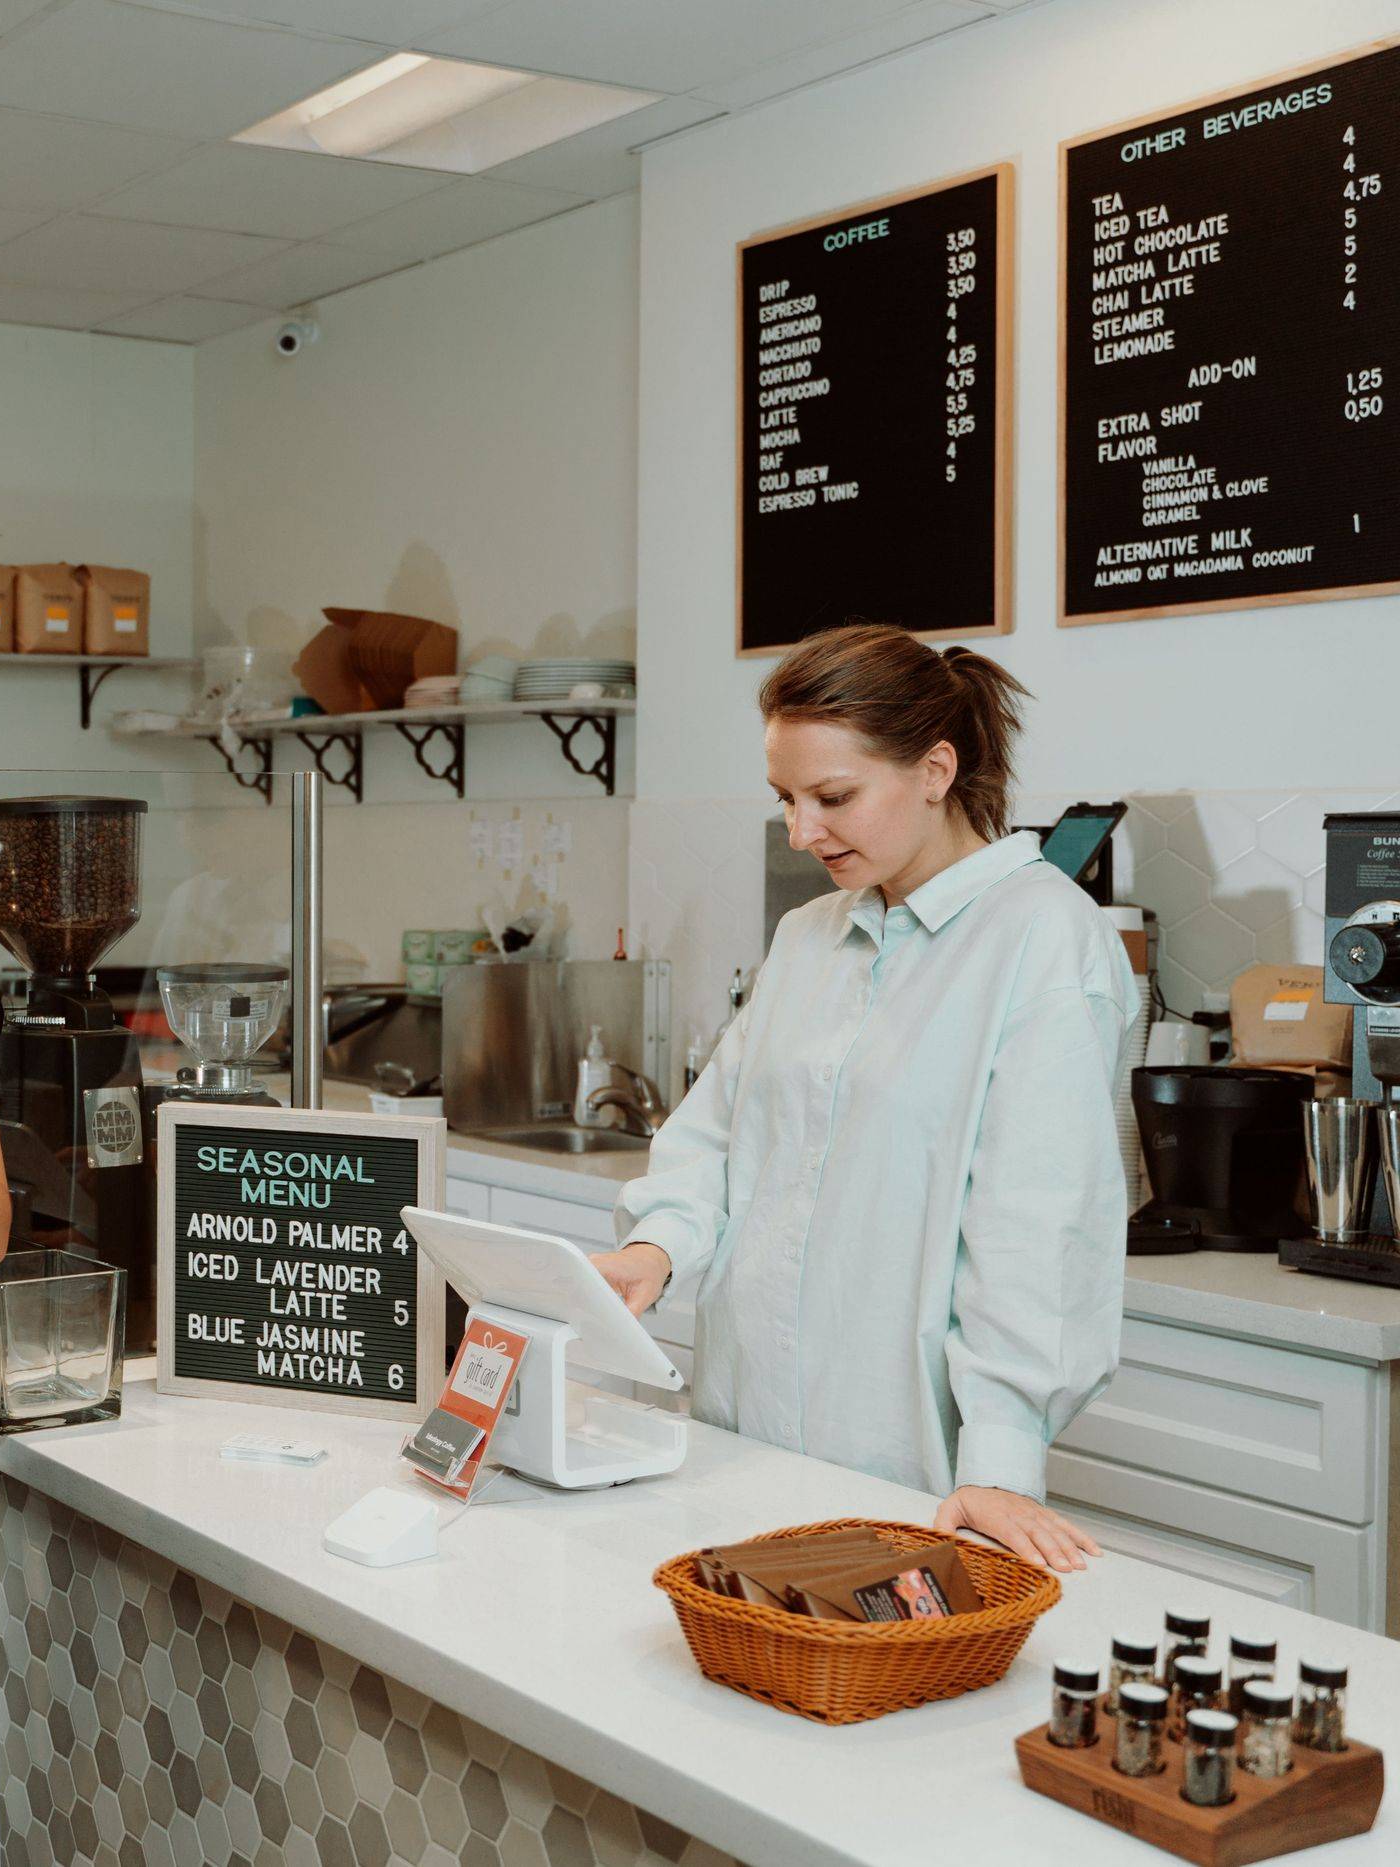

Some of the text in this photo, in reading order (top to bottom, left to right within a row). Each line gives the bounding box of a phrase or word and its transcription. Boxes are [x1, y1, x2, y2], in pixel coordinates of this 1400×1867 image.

[1120, 83, 1332, 164] OTHER BEVERAGES
[1092, 126, 1355, 216] TEA 4
[1094, 153, 1355, 241] ICED TEA 4
[823, 219, 890, 252] COFFEE
[1093, 174, 1381, 266] HOT CHOCOLATE 4.75
[759, 228, 976, 303] DRIP 3.50
[1093, 208, 1356, 291] MATCHA LATTE 5
[759, 251, 976, 324] ESPRESSO 3.50
[1092, 235, 1356, 316] CHAI LATTE 5
[759, 275, 976, 345] AMERICANO 3.50
[1092, 263, 1356, 341] STEAMER 2
[759, 302, 957, 366] MACCHIATO 4
[1094, 290, 1355, 365] LEMONADE 4
[759, 326, 957, 387] CORTADO 4
[1188, 356, 1256, 388] ADD-ON
[759, 378, 830, 408] CAPPUCCINO
[1098, 368, 1382, 438] EXTRA SHOT 1.25
[760, 407, 797, 428] LATTE
[760, 429, 800, 450] MOCHA
[1098, 396, 1383, 463] FLAVOR 0.50
[759, 441, 957, 492] COLD BREW 4
[760, 452, 783, 471] RAF
[1142, 467, 1216, 493] CHOCOLATE
[1143, 455, 1195, 476] VANILLA
[759, 465, 957, 513] ESPRESSO TONIC 5
[1143, 477, 1268, 510] CINNAMON & CLOVE
[1143, 506, 1200, 526] CARAMEL
[1097, 513, 1360, 566] ALTERNATIVE MILK 1
[1094, 546, 1314, 587] ALMOND OAT MACADAMIA COCONUT
[1367, 848, 1395, 860] Coffee
[197, 1146, 375, 1184] SEASONAL
[241, 1178, 331, 1209] MENU
[187, 1212, 409, 1256] ARNOLD PALMER 4
[188, 1251, 381, 1295] ICED LAVENDER
[270, 1288, 409, 1327] LATTE 5
[188, 1313, 365, 1357] BLUE JASMINE
[257, 1350, 404, 1391] MATCHA 6
[464, 1356, 502, 1389] gift card
